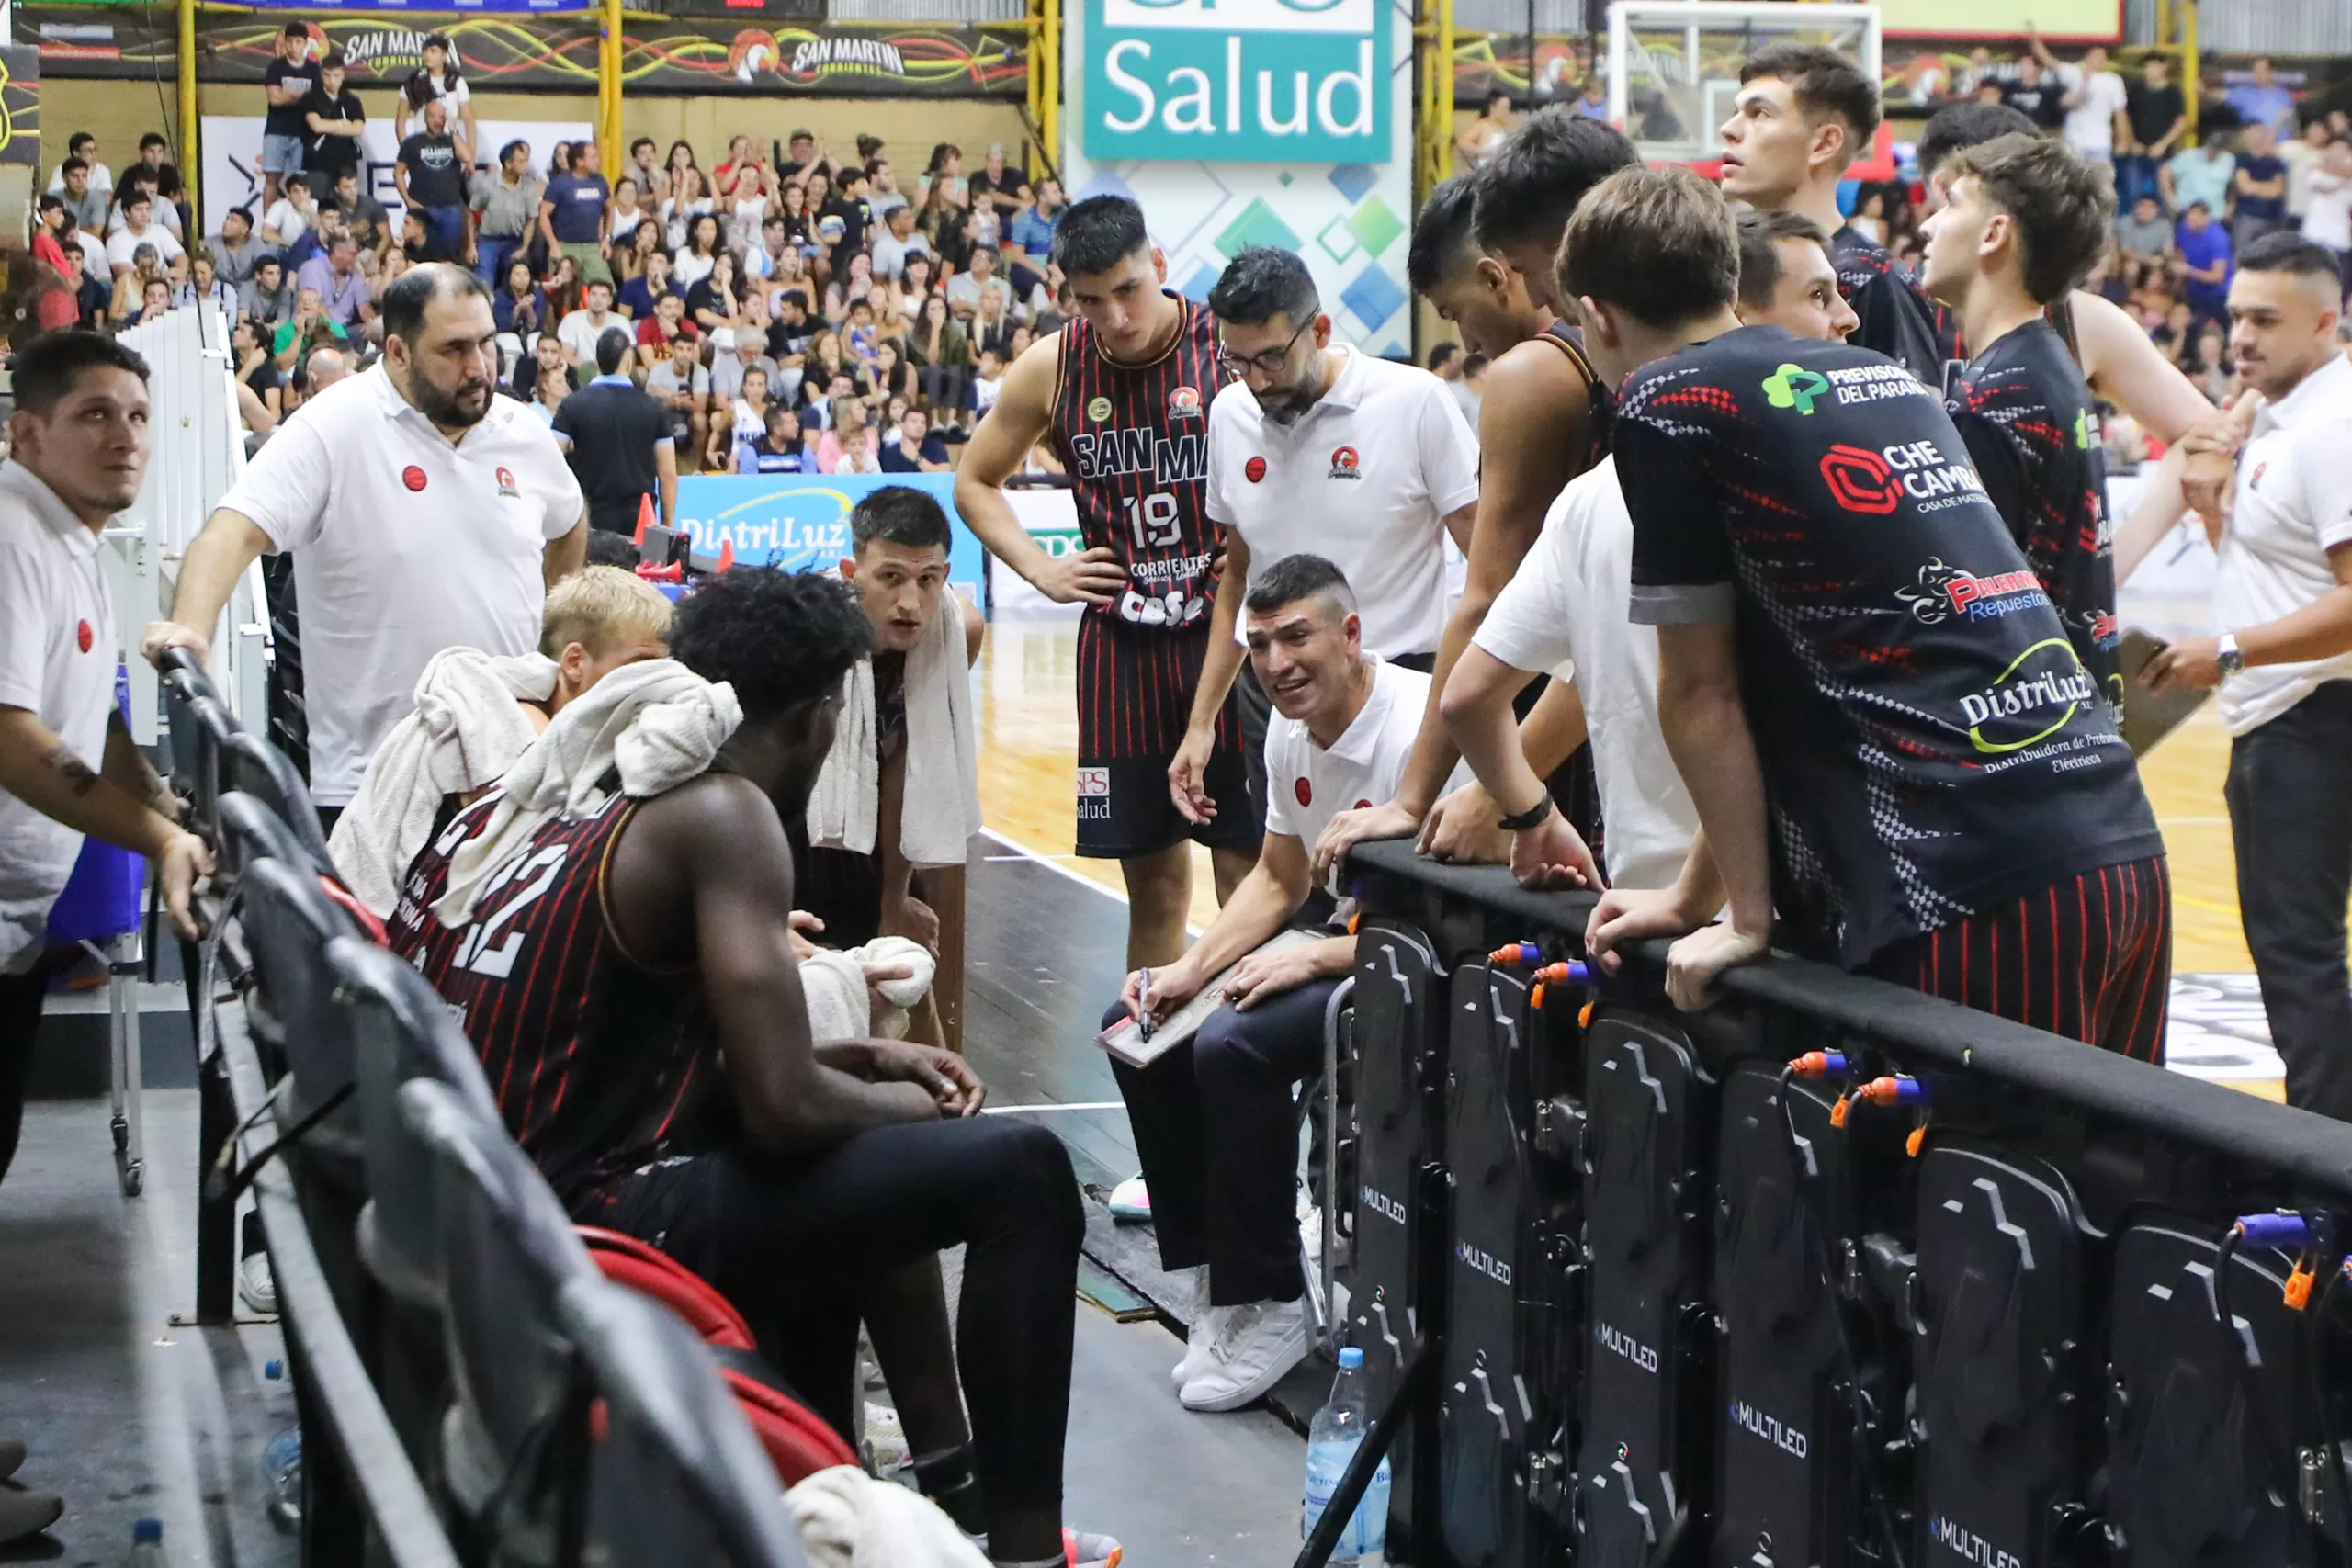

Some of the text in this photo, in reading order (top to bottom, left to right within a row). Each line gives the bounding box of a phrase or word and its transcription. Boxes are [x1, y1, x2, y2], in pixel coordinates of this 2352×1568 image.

[344, 30, 461, 69] SAN MARN
[792, 38, 905, 75] SAN MARTIN
[1103, 36, 1374, 136] Salud
[1838, 384, 1871, 405] DEL
[1071, 427, 1154, 479] SAN
[1883, 440, 1946, 471] CHE
[1123, 492, 1182, 549] 19
[1917, 500, 1944, 513] CASA
[1942, 495, 1958, 508] DE
[680, 517, 846, 551] DistriLuz
[1130, 552, 1212, 577] CORRIENTES
[1969, 591, 2050, 623] Repuestos
[1960, 671, 2092, 727] DistriLuz
[1984, 741, 2071, 773] Distribuidora
[2073, 736, 2085, 750] de
[1078, 797, 1111, 819] alud
[1364, 1185, 1406, 1225] MULTILED
[1463, 1241, 1511, 1286] MULTILED
[1601, 1322, 1658, 1373] MULTILED
[1739, 1401, 1807, 1459] MULTILED
